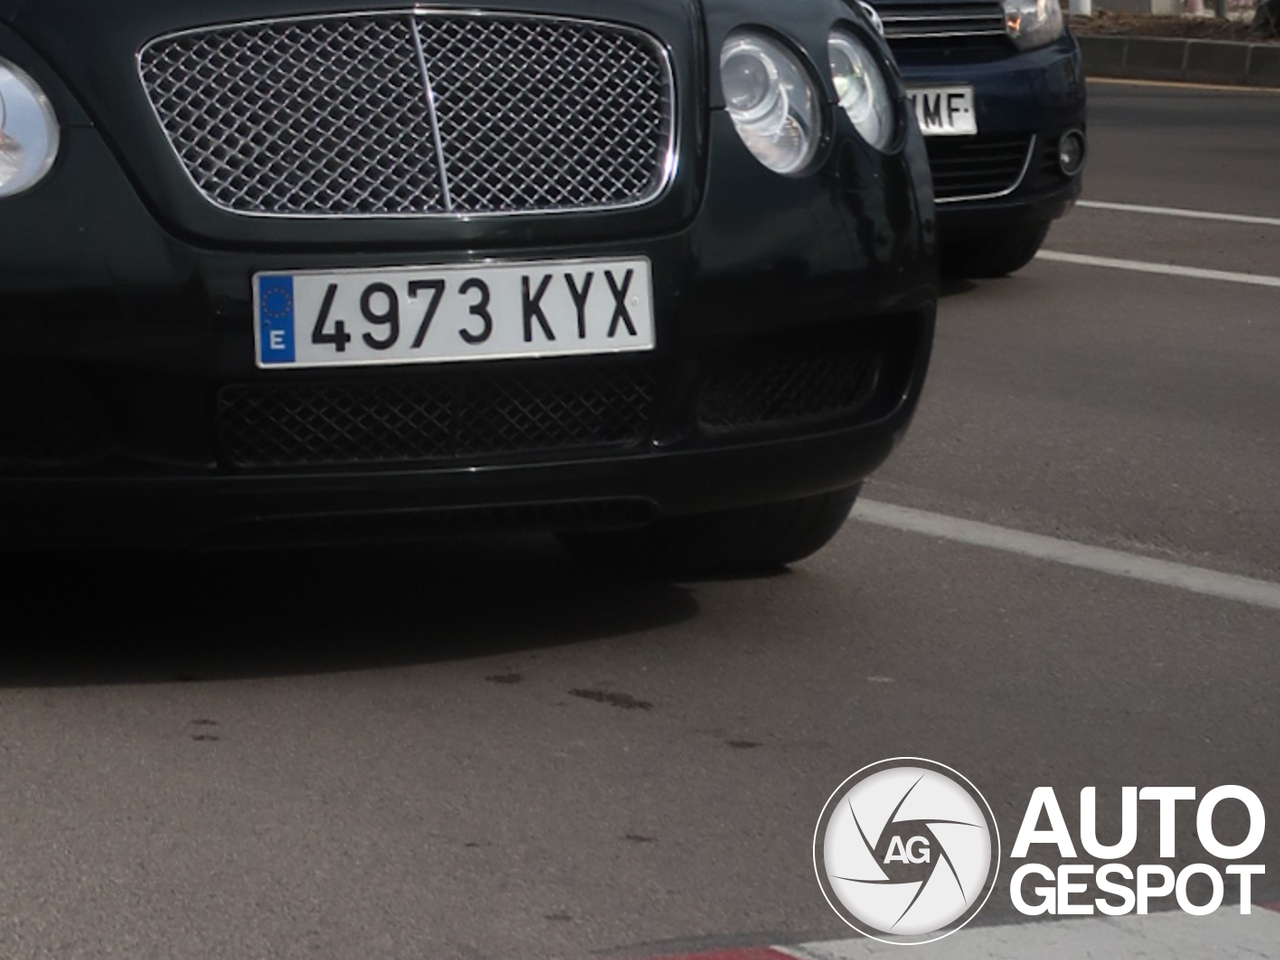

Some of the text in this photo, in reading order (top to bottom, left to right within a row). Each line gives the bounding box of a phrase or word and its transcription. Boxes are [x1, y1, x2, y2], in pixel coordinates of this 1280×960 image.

[912, 93, 965, 129] MF
[269, 269, 638, 352] E 4973 KYX
